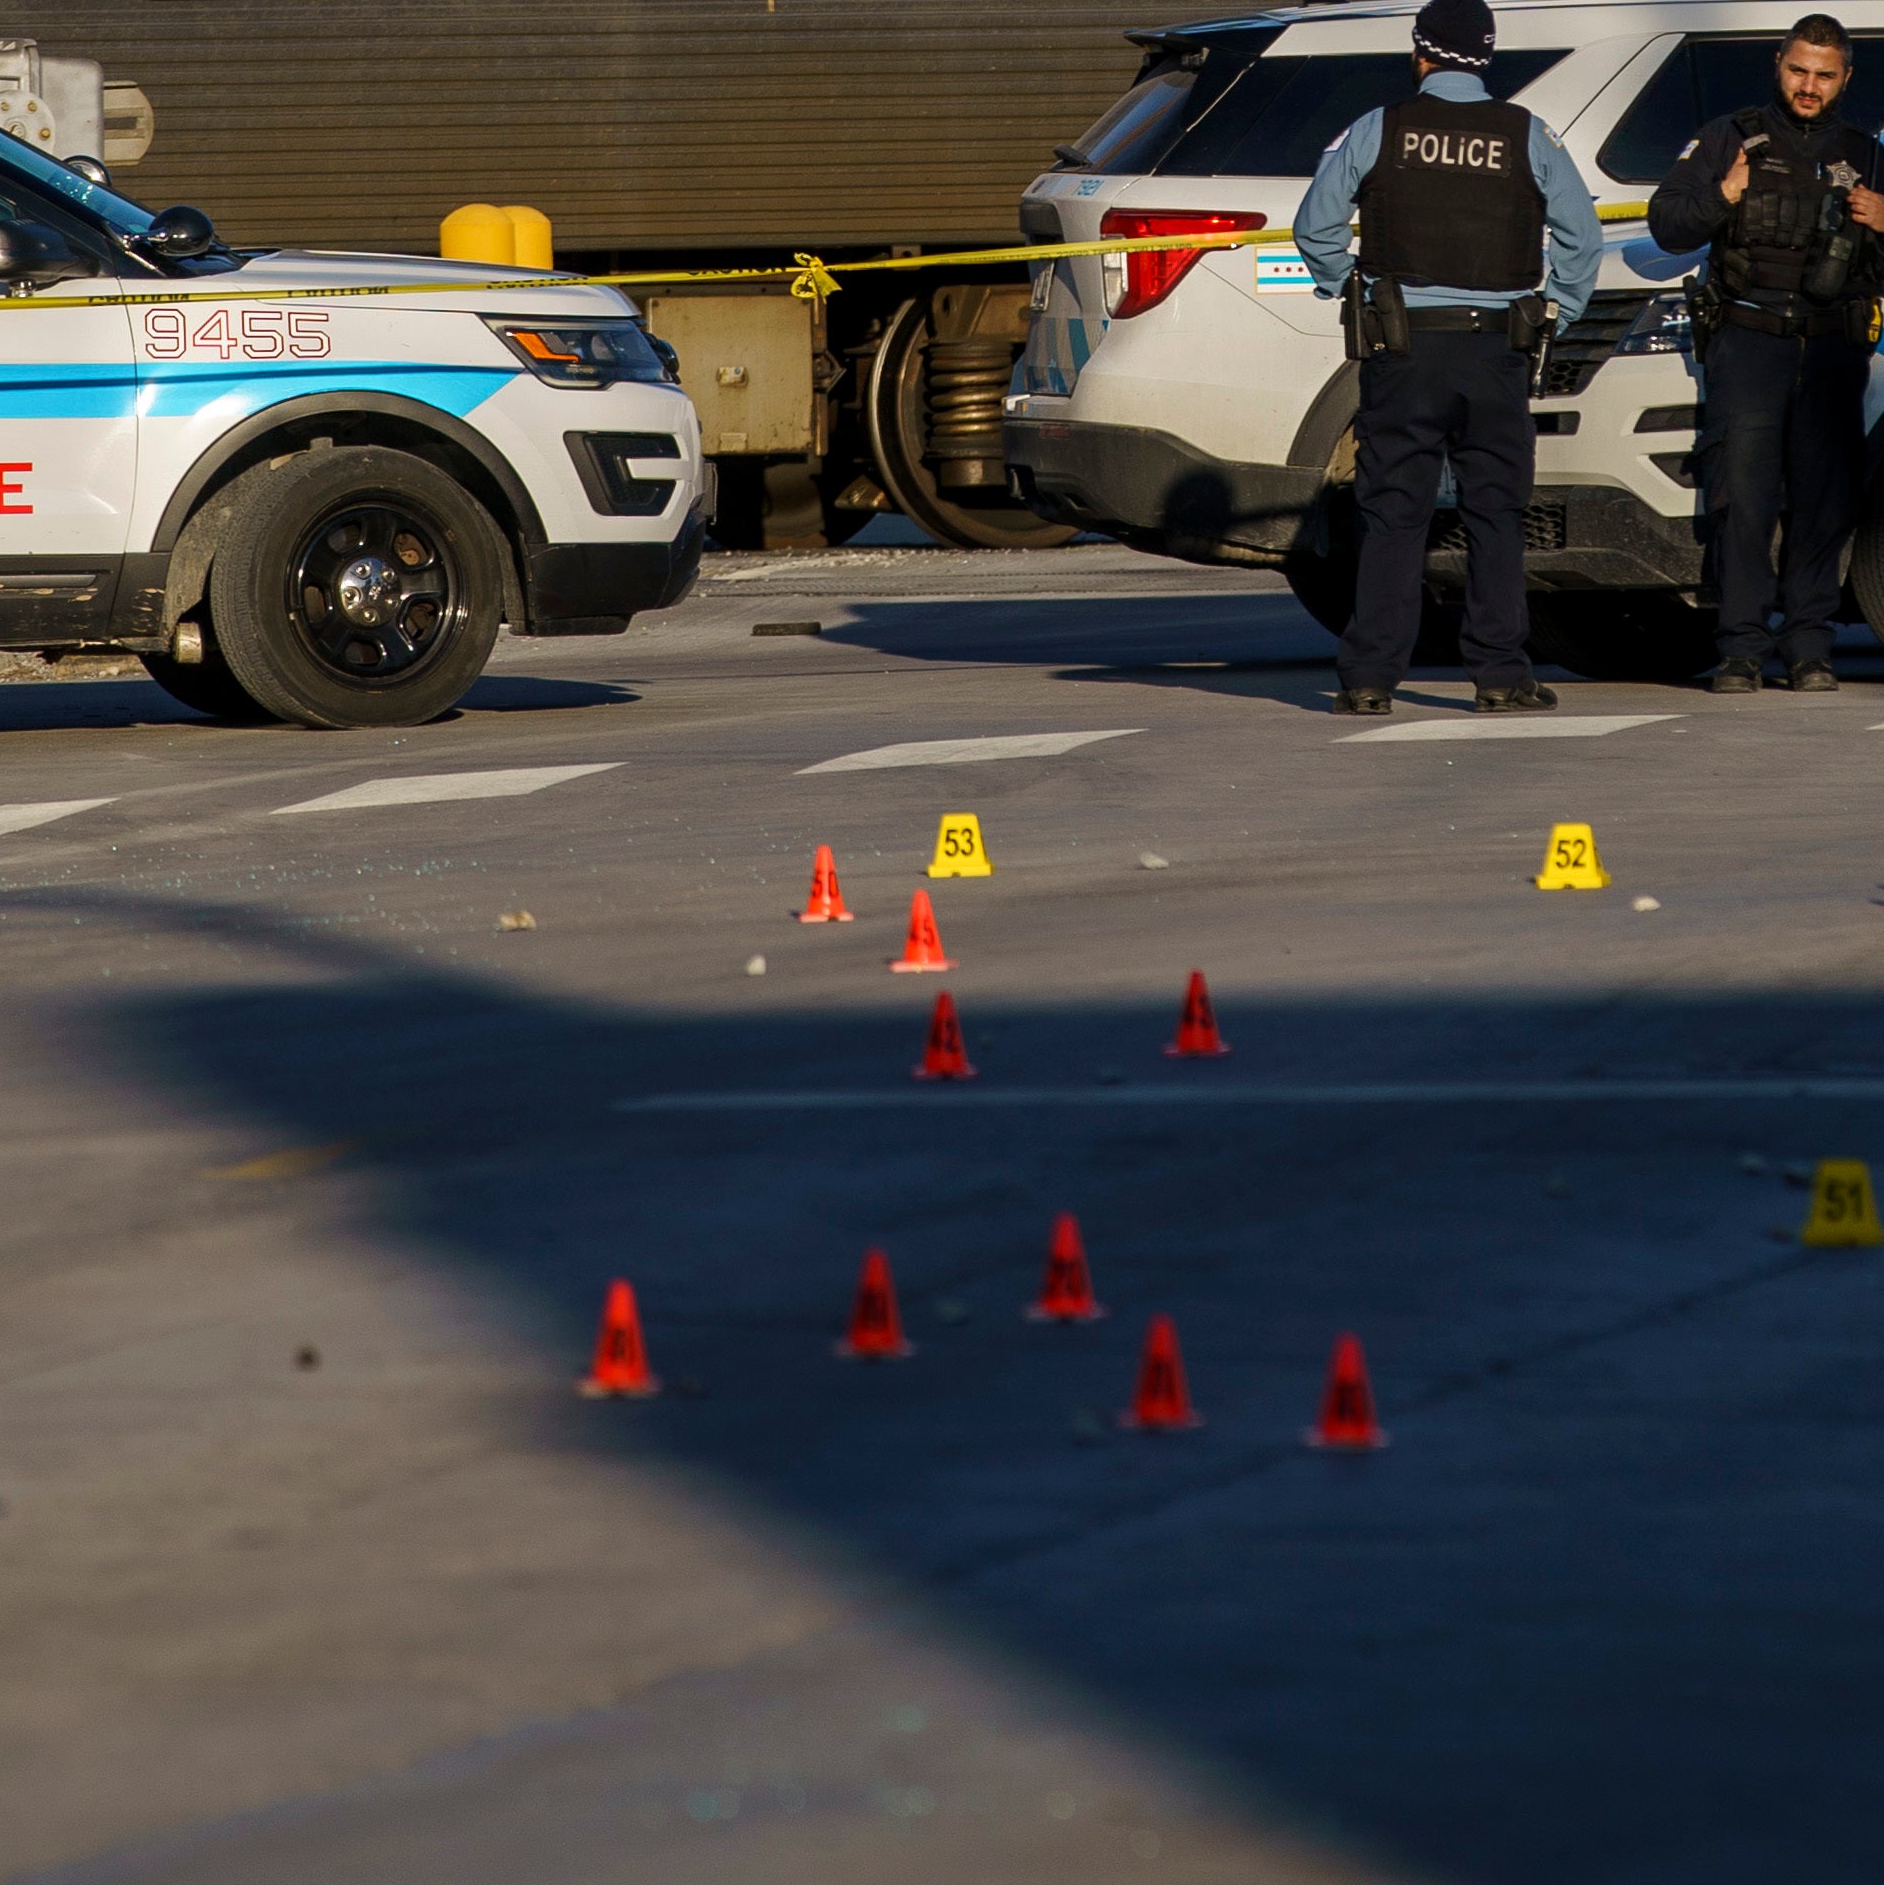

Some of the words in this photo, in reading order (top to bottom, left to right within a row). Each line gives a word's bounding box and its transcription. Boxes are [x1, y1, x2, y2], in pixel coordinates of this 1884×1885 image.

[1402, 131, 1505, 170] POLICE
[144, 307, 332, 360] 9455
[944, 827, 975, 857] 53
[1555, 838, 1587, 869] 52
[1825, 1179, 1864, 1222] 51
